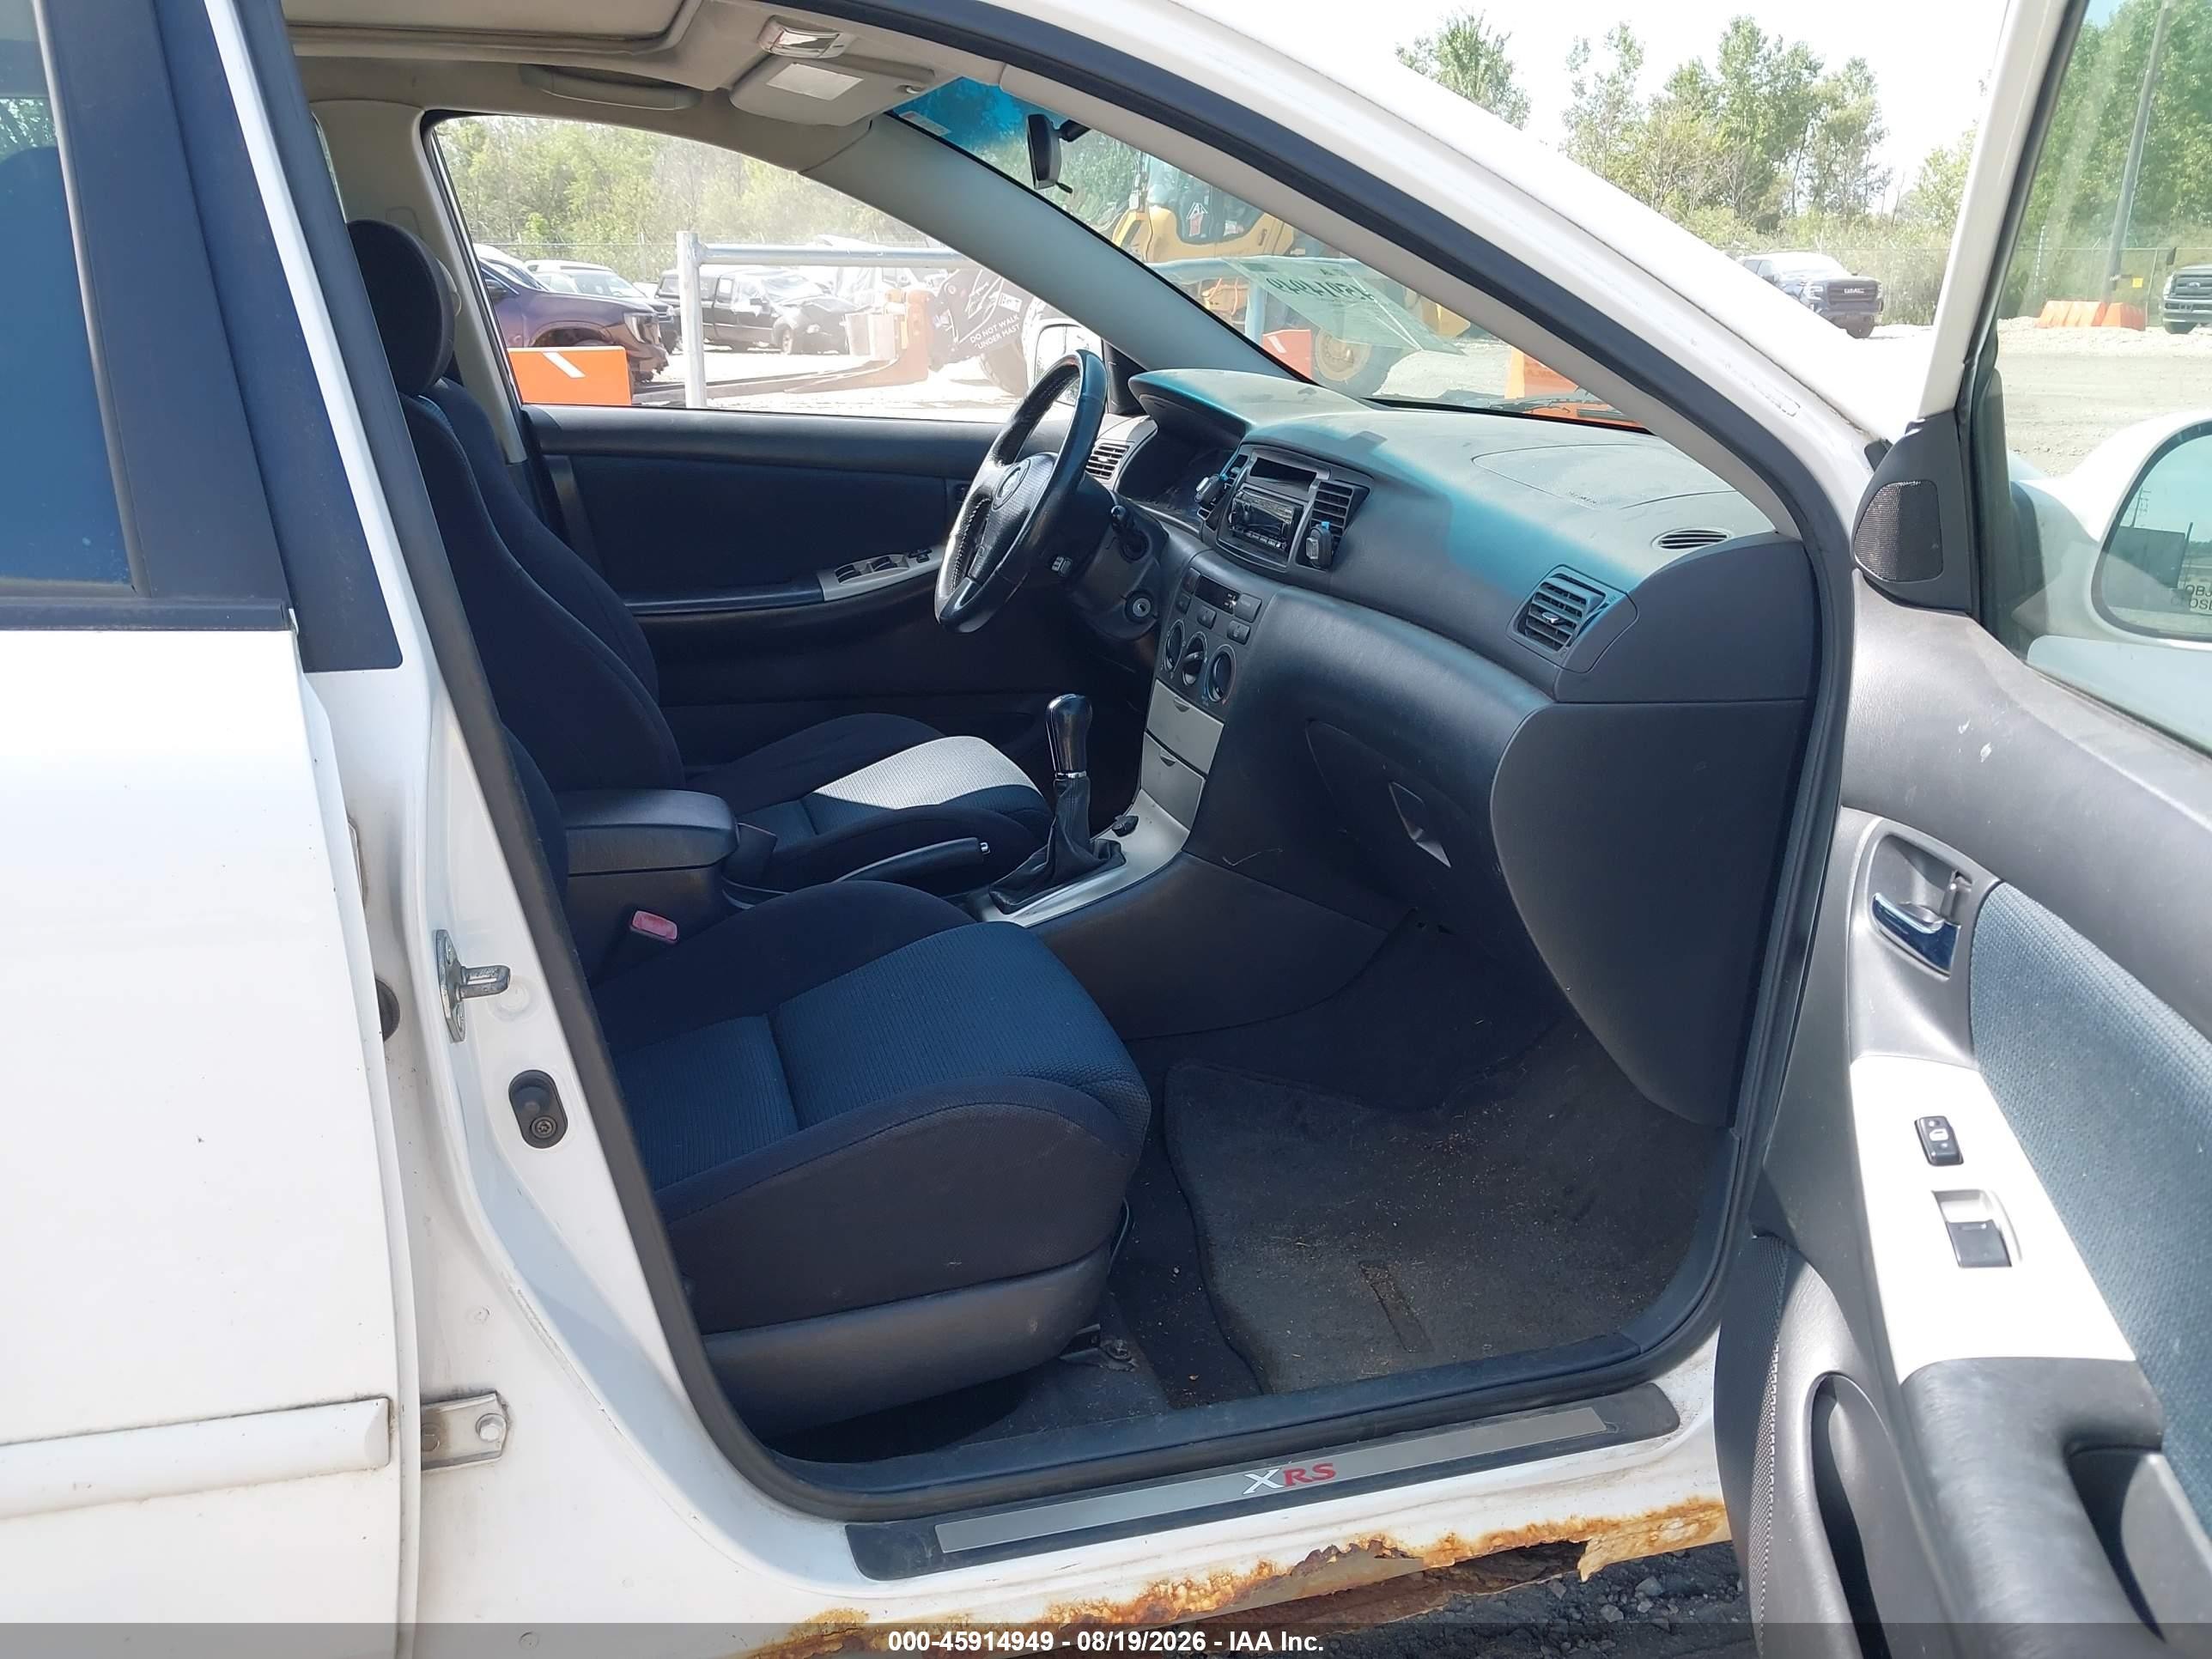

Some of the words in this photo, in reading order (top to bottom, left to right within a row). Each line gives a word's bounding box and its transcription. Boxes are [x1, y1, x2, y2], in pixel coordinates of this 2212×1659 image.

[969, 334, 981, 343] DO
[981, 325, 997, 338] NOT
[998, 313, 1020, 328] WALK
[977, 332, 1002, 349] UNDER
[1001, 323, 1021, 338] MAST
[1242, 1462, 1337, 1495] XRS
